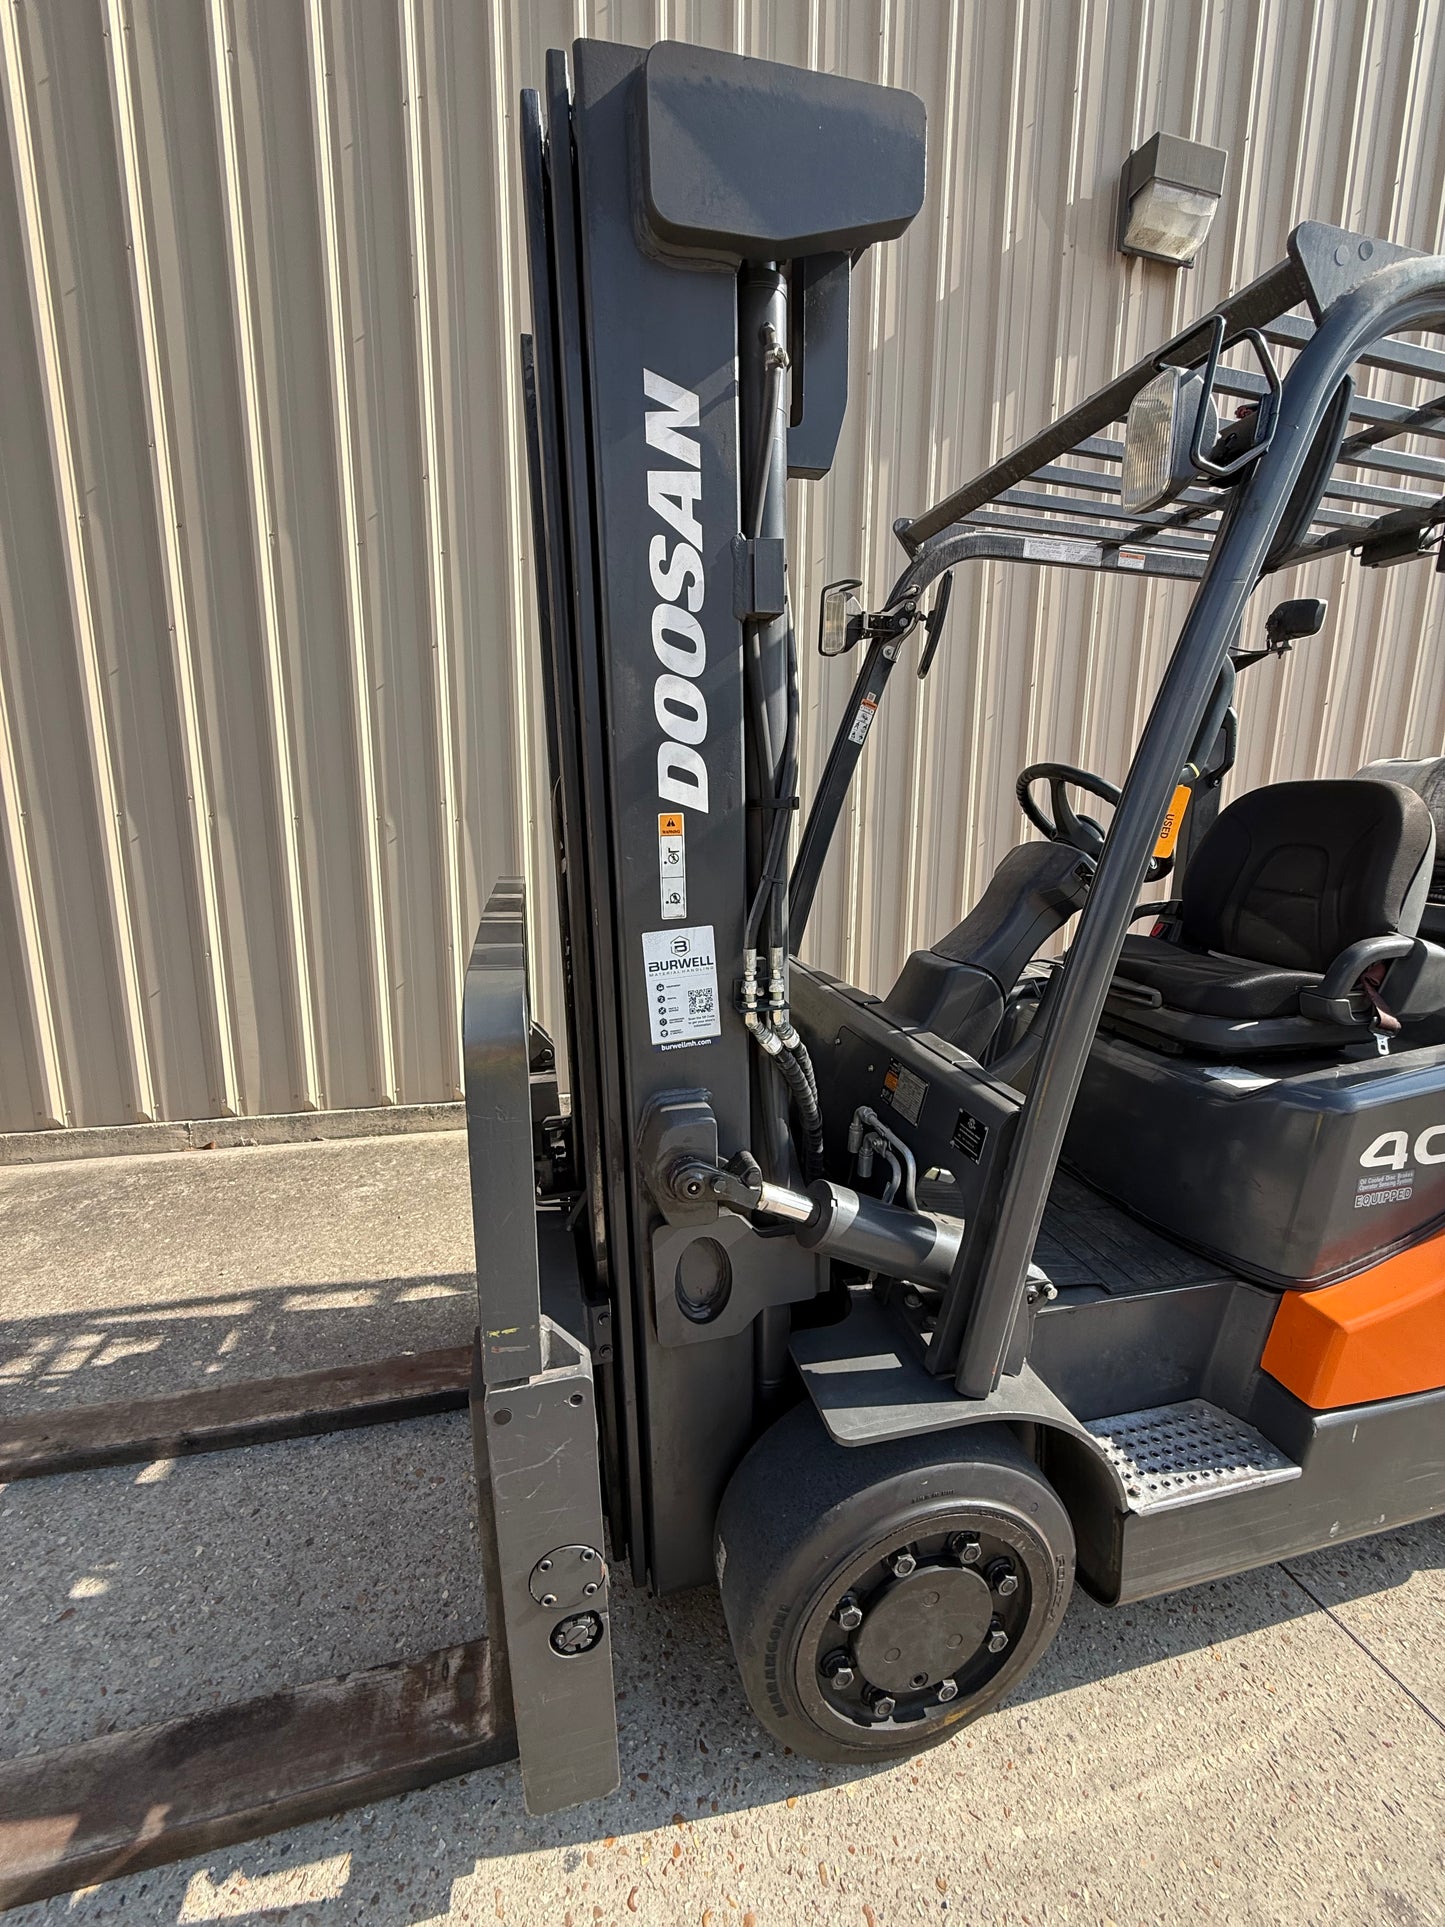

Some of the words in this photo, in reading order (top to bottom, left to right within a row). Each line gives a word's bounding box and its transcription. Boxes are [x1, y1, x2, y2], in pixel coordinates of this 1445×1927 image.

[643, 367, 709, 814] DOOSAN
[1160, 813, 1175, 839] USED
[648, 955, 714, 972] BURWELL
[649, 970, 682, 978] MATERIAL
[661, 1038, 712, 1051] burwellmh.com
[1367, 1176, 1385, 1184] Cooled
[1378, 1181, 1396, 1189] Sensing
[1396, 1178, 1413, 1187] System
[1354, 1187, 1413, 1209] EQUIPPED
